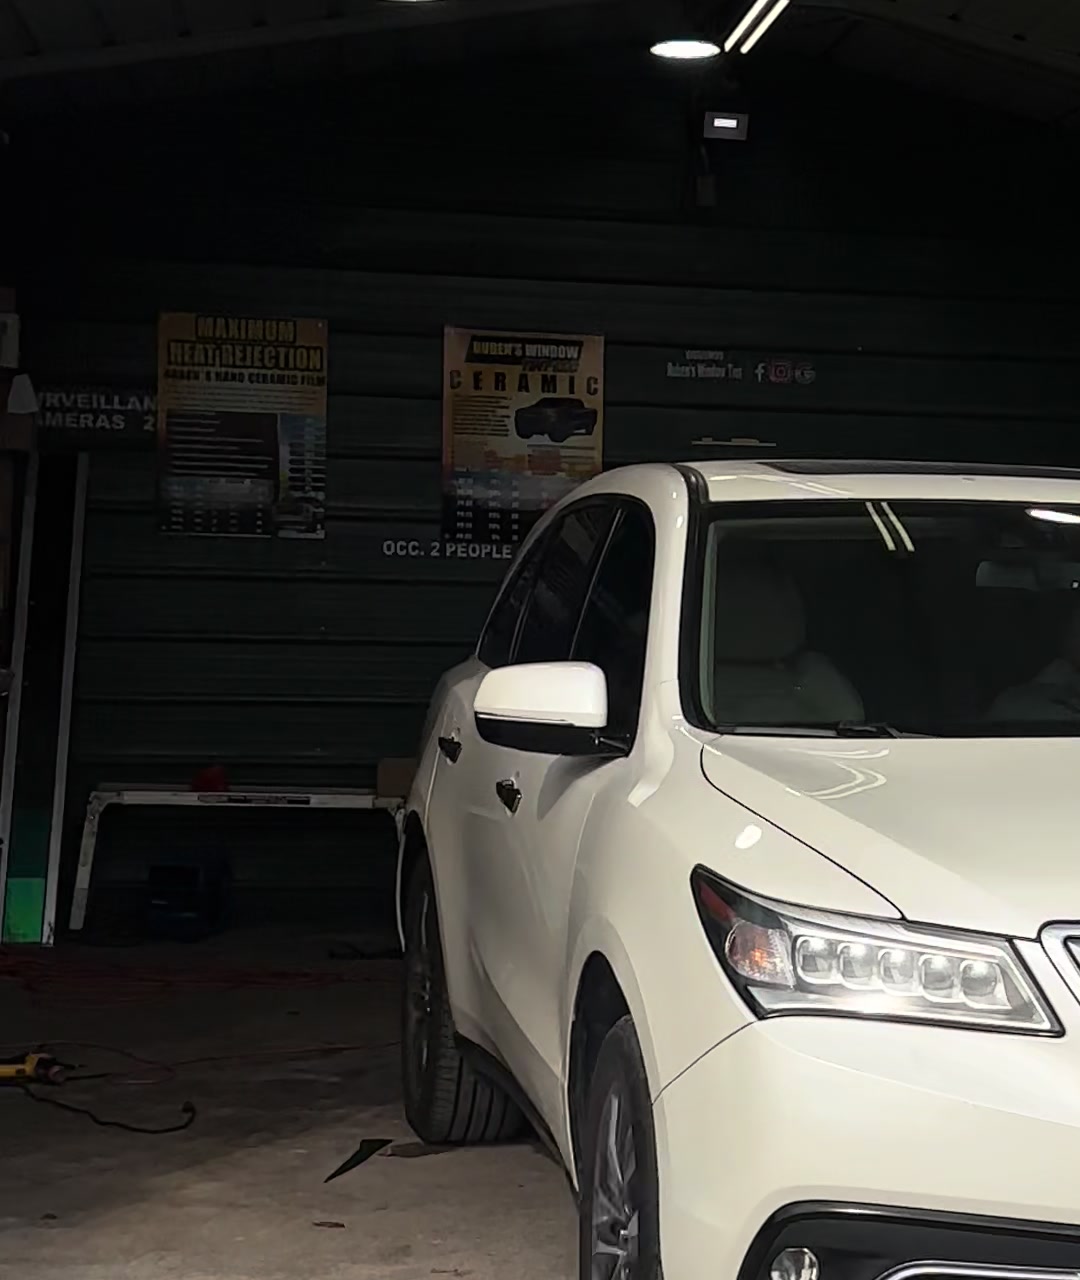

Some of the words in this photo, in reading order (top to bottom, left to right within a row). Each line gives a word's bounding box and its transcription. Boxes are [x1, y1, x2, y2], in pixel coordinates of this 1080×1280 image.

[197, 317, 296, 342] MAXIMUM
[168, 341, 217, 366] HEAT
[217, 344, 323, 371] REJECTION
[525, 344, 580, 359] WINDOW
[449, 369, 599, 396] CERAMIC
[382, 540, 425, 556] OCC.
[430, 541, 440, 557] 2
[445, 543, 513, 559] PEOPLE
